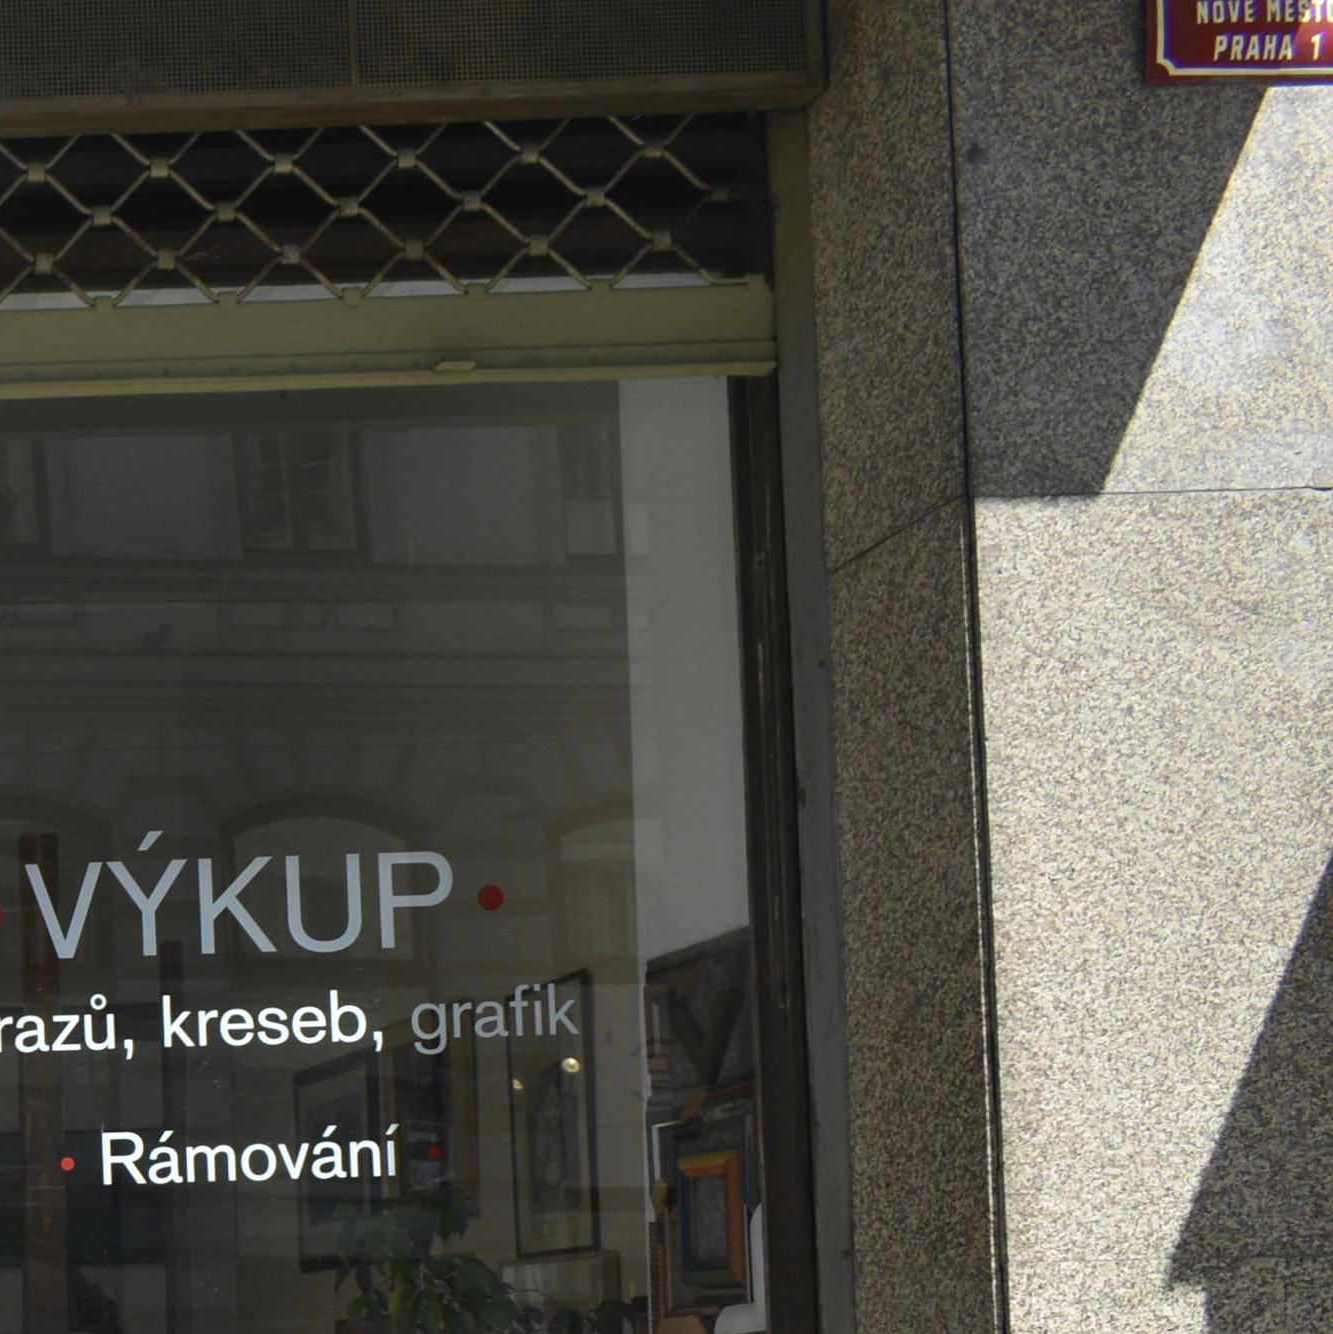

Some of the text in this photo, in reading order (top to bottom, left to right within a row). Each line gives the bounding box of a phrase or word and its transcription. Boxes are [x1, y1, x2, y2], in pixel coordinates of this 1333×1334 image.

[1213, 33, 1322, 61] PRAHA 1
[25, 830, 454, 960] VÝKUP
[161, 990, 385, 1053] kreseb,
[410, 983, 579, 1055] grafik
[101, 1123, 400, 1186] Rámování
